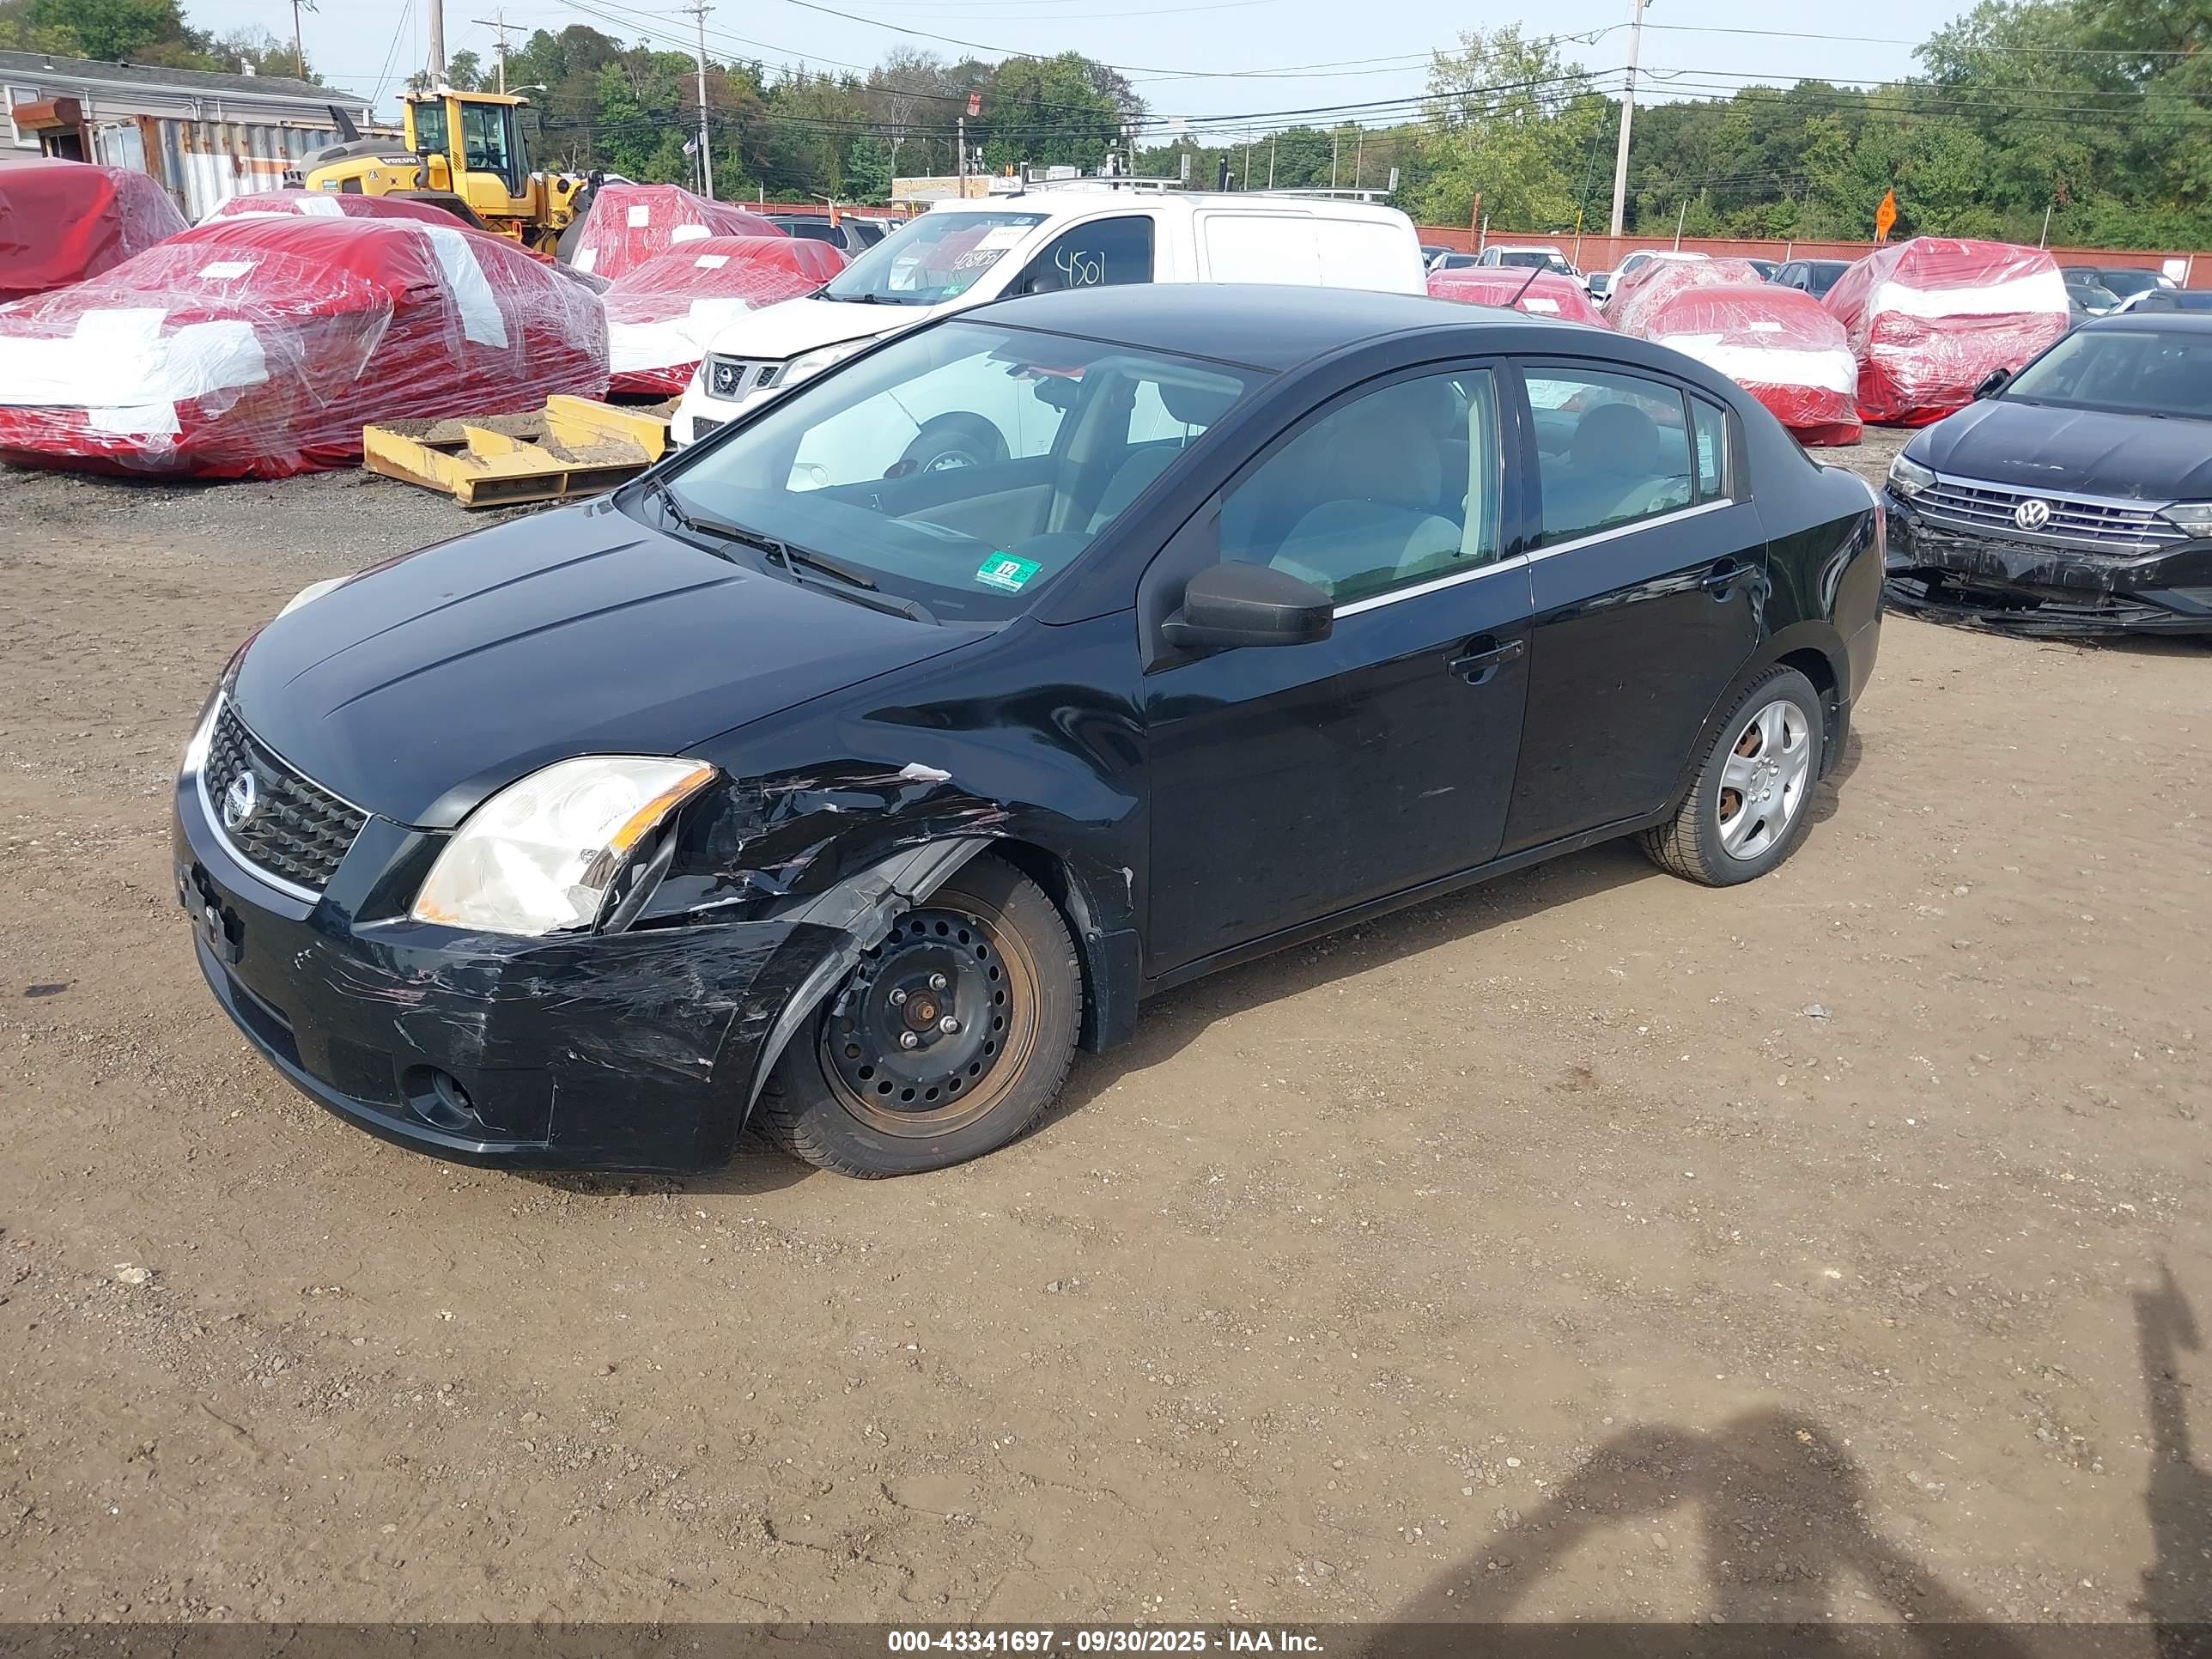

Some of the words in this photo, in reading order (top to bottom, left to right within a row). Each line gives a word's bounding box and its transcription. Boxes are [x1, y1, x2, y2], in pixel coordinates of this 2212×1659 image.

[1054, 245, 1105, 288] 4501
[986, 560, 1000, 569] 20
[998, 562, 1017, 575] 12
[1016, 569, 1030, 578] 25
